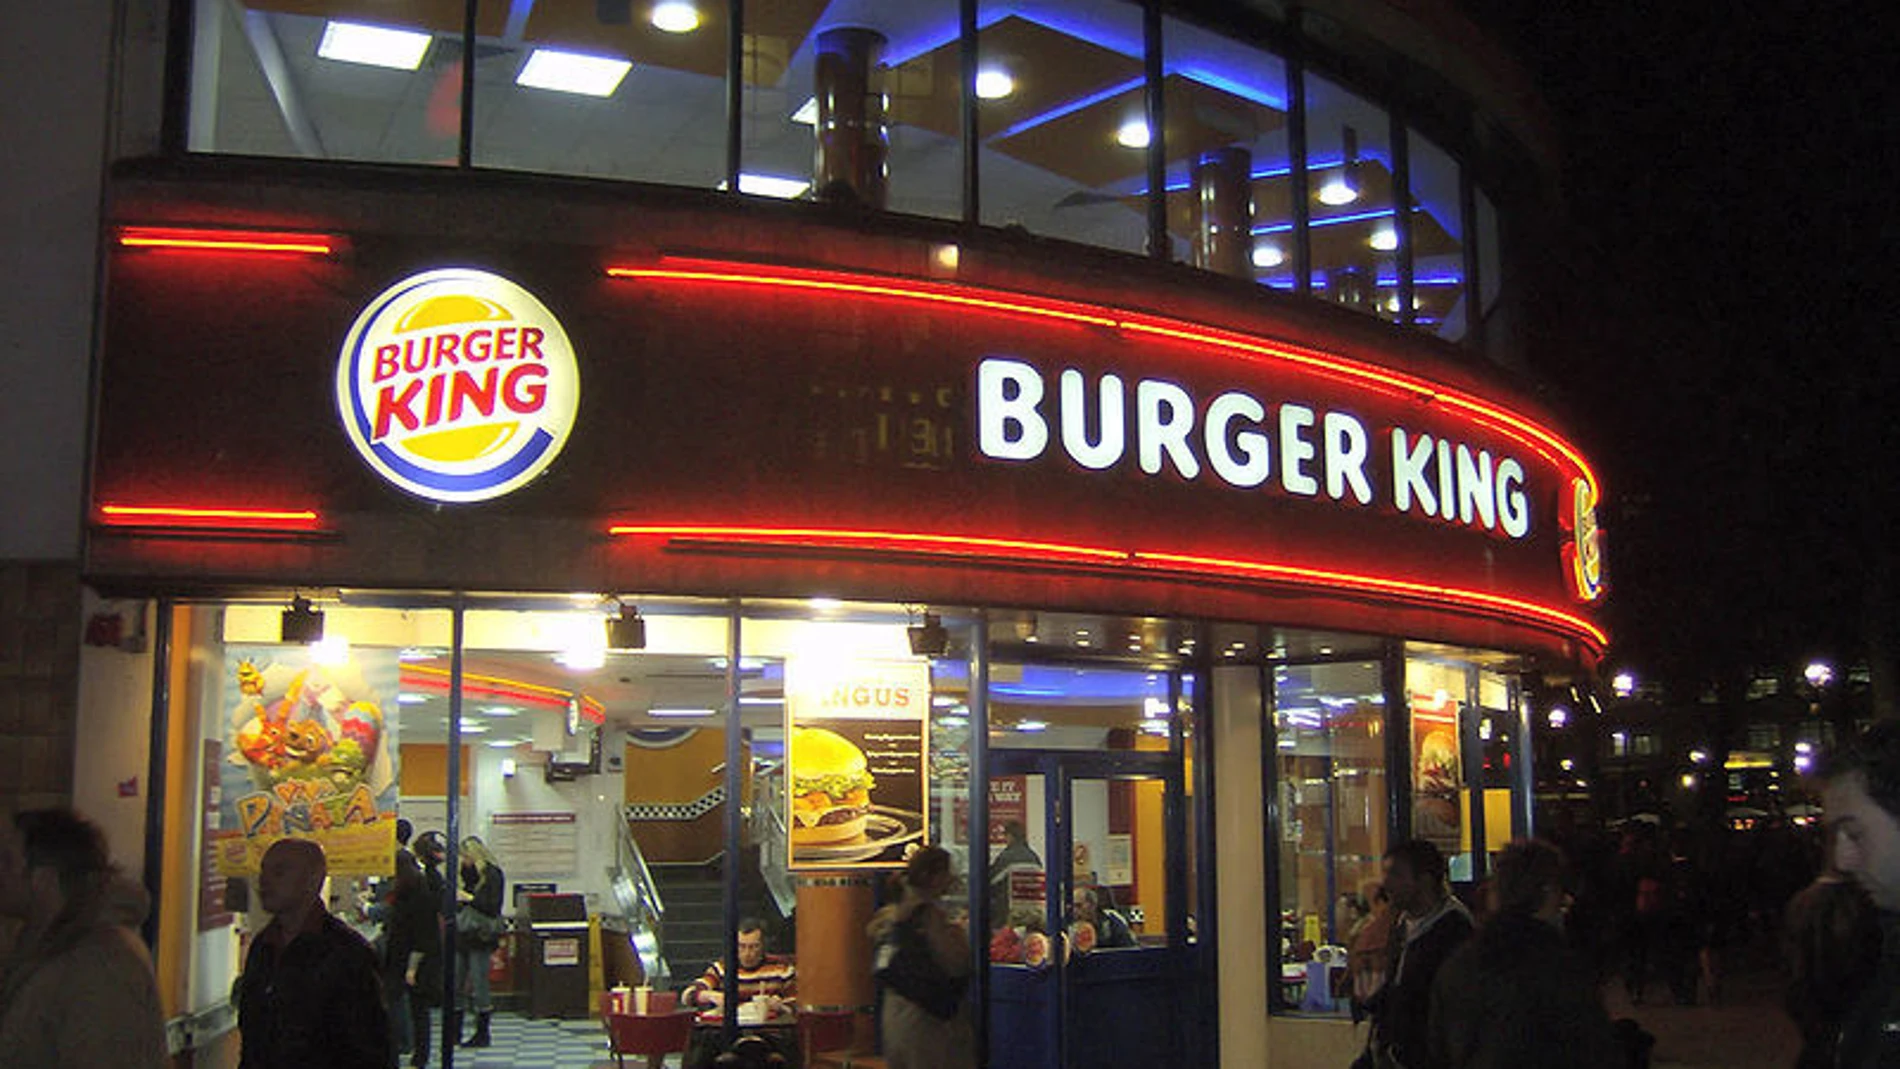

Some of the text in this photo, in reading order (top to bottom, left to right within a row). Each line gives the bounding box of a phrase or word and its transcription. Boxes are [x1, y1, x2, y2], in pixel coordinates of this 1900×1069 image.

[372, 327, 545, 383] BURGER
[372, 362, 549, 440] KING
[979, 359, 1372, 505] BURGER
[1391, 427, 1529, 538] KING
